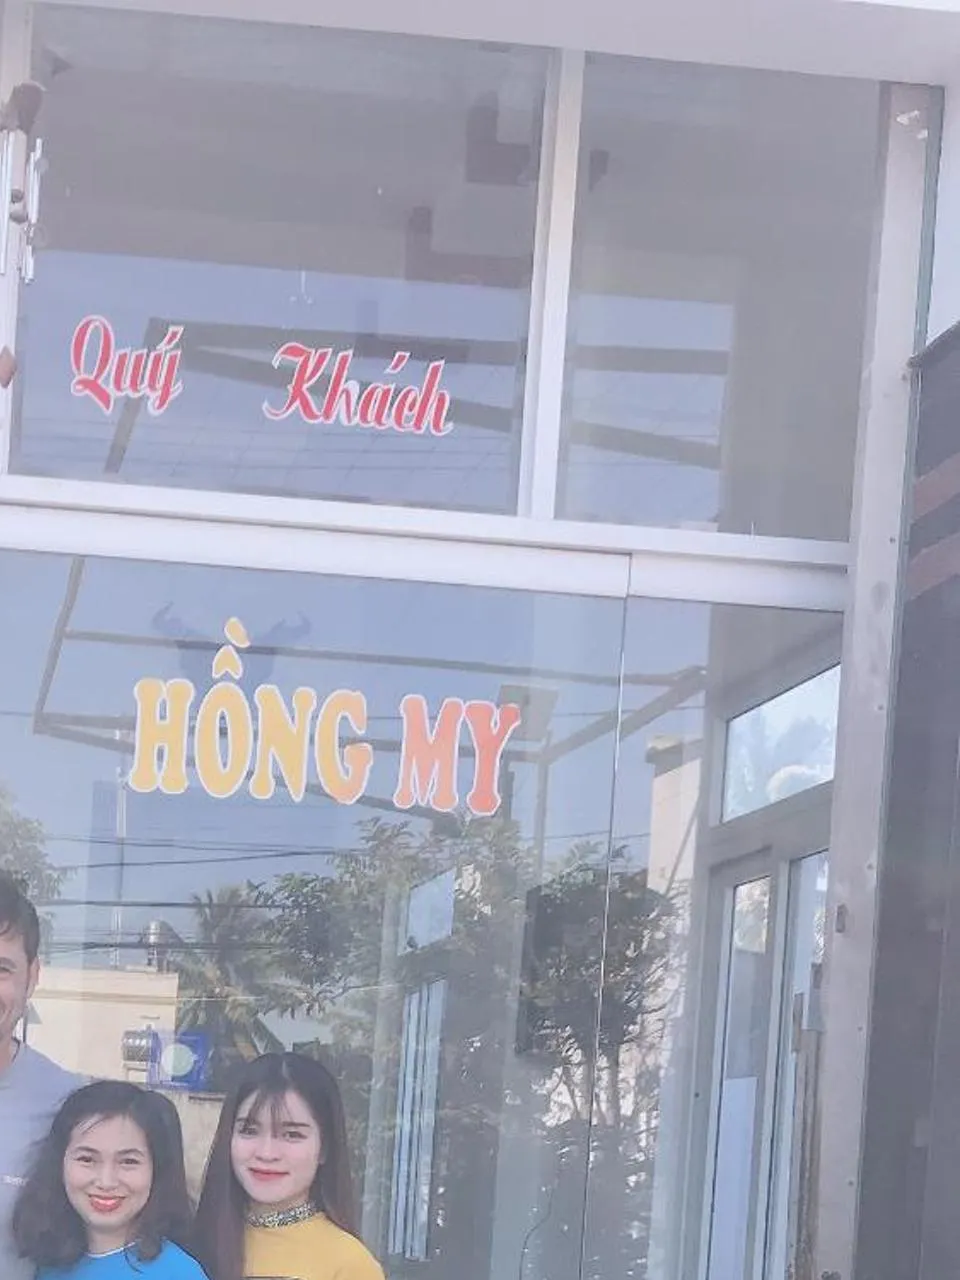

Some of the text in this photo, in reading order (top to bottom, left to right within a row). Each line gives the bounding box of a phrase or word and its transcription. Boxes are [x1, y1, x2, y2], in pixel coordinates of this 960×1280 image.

[71, 315, 184, 416] Quý
[262, 342, 454, 436] Khách
[129, 616, 374, 806] HỒNG
[393, 694, 522, 816] MY
